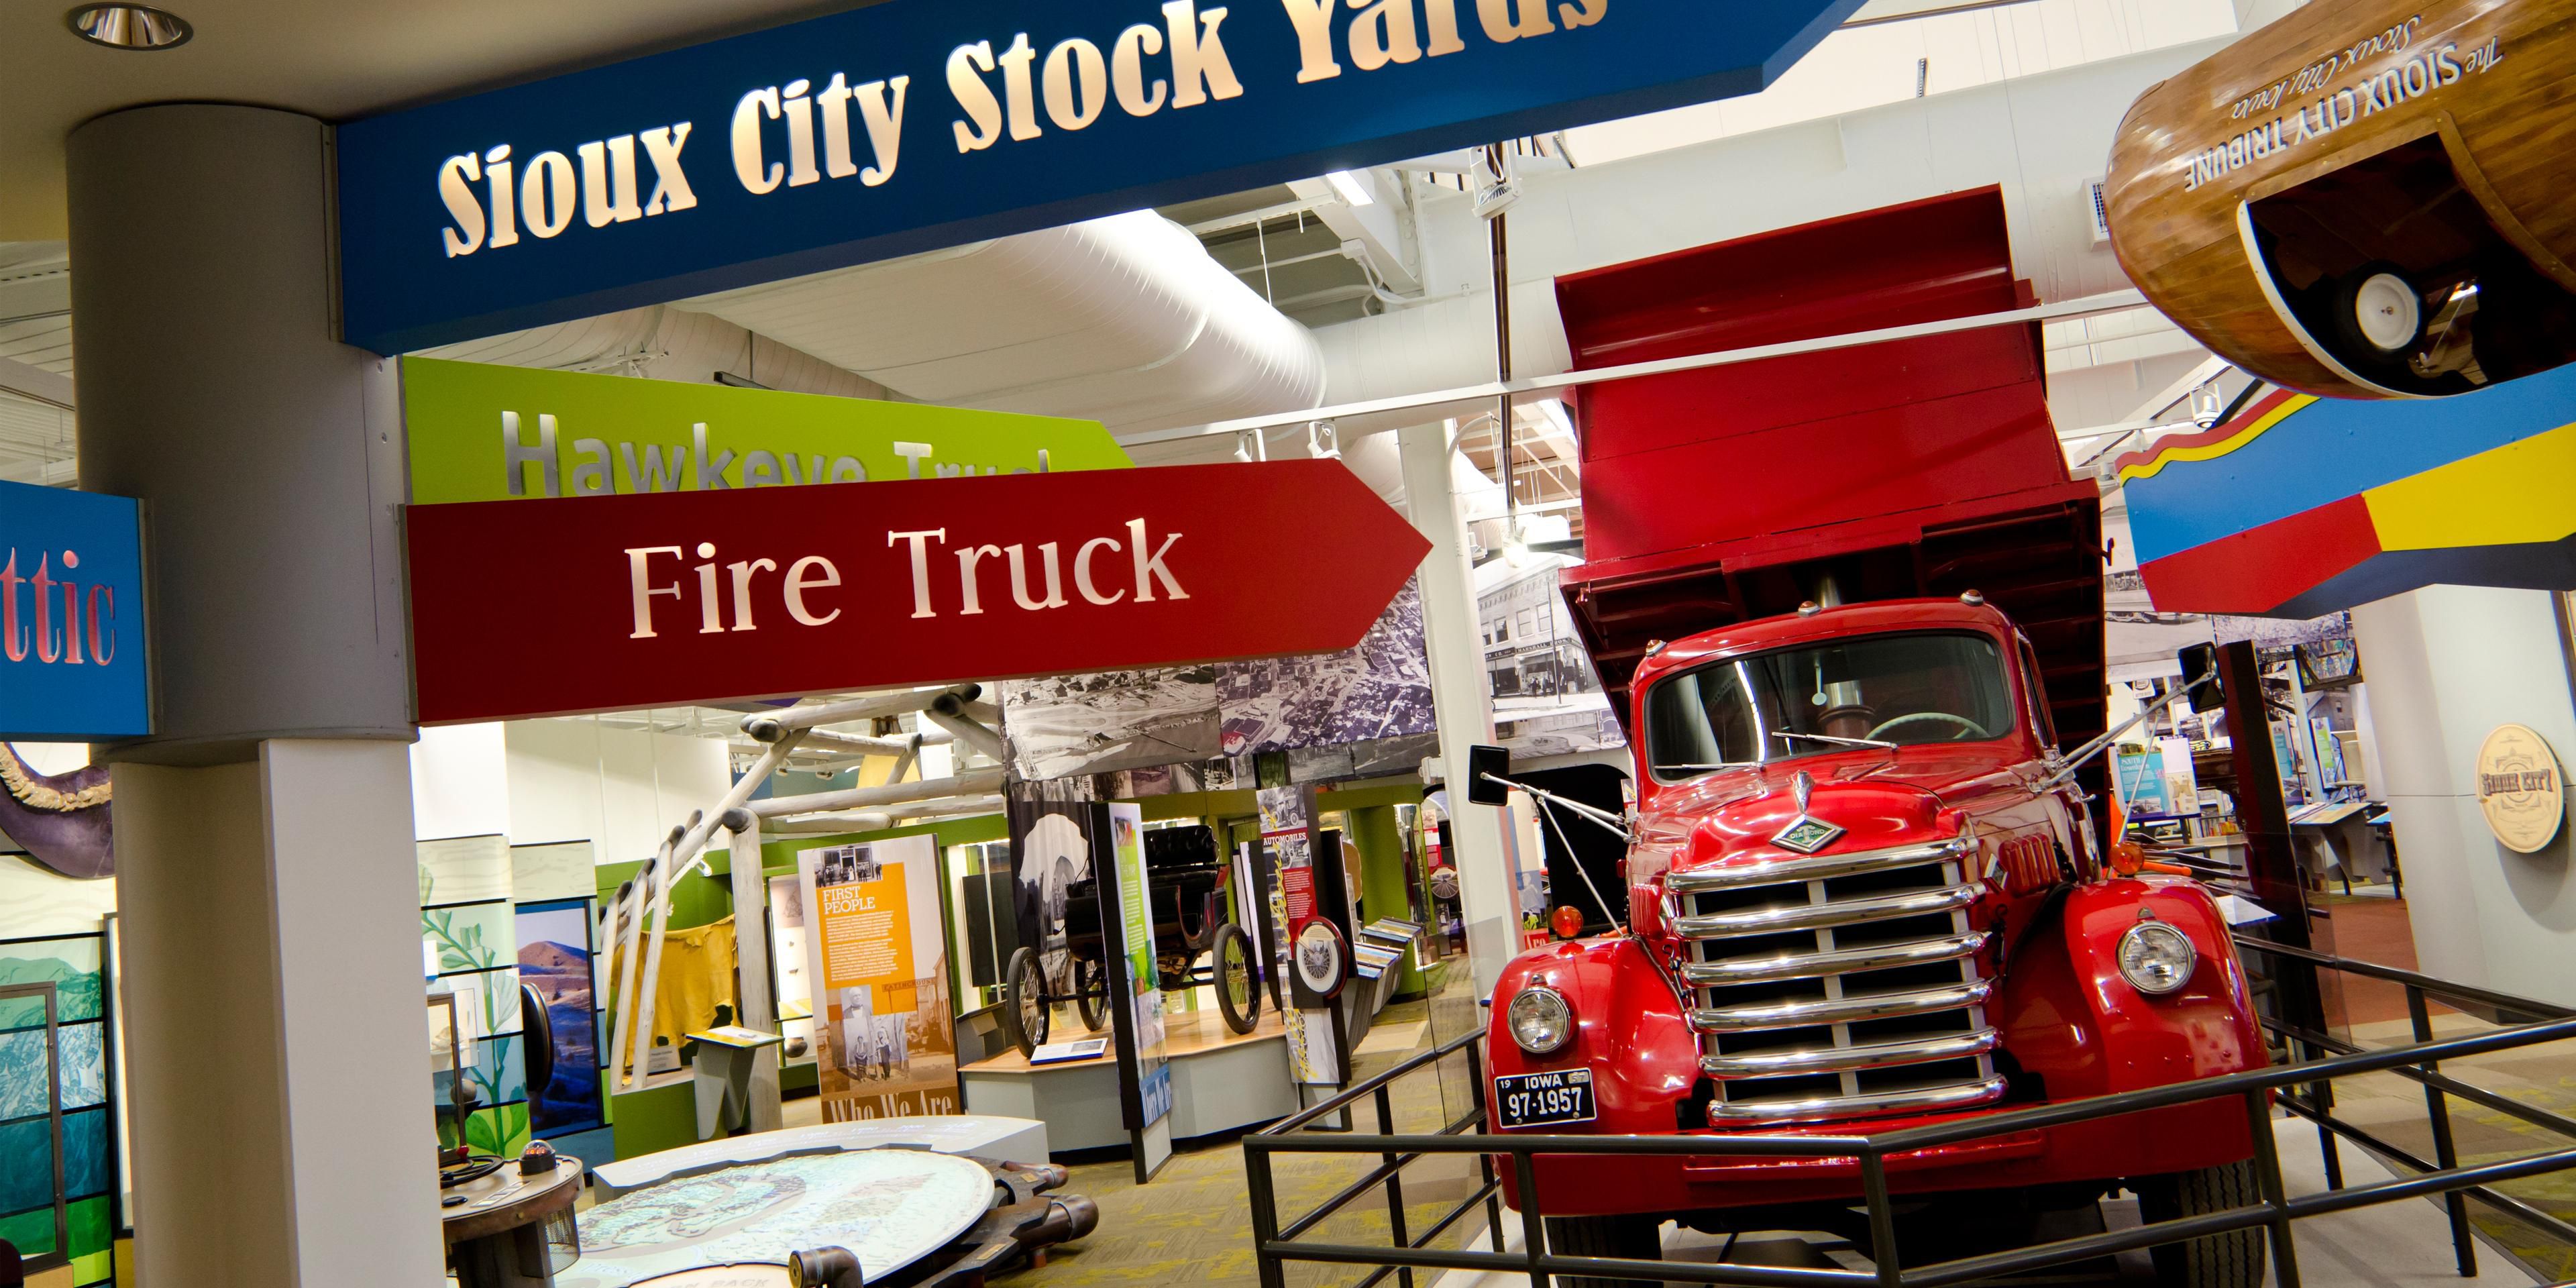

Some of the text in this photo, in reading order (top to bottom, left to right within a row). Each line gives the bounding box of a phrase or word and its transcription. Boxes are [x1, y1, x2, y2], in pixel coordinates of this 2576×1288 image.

[2184, 36, 2504, 193] The SIOUX CITY TRIBUNE
[438, 121, 698, 259] Sioux
[731, 72, 909, 195] City
[946, 0, 1244, 154] Stock
[624, 518, 1190, 639] Fire Truck
[1263, 832, 1307, 845] AUTOMOBILES
[822, 885, 861, 902] FIRST
[824, 897, 875, 914] PEOPLE
[1500, 1079, 1511, 1089] 19
[1525, 1074, 1562, 1089] IOWA
[829, 1090, 953, 1124] Who We Are
